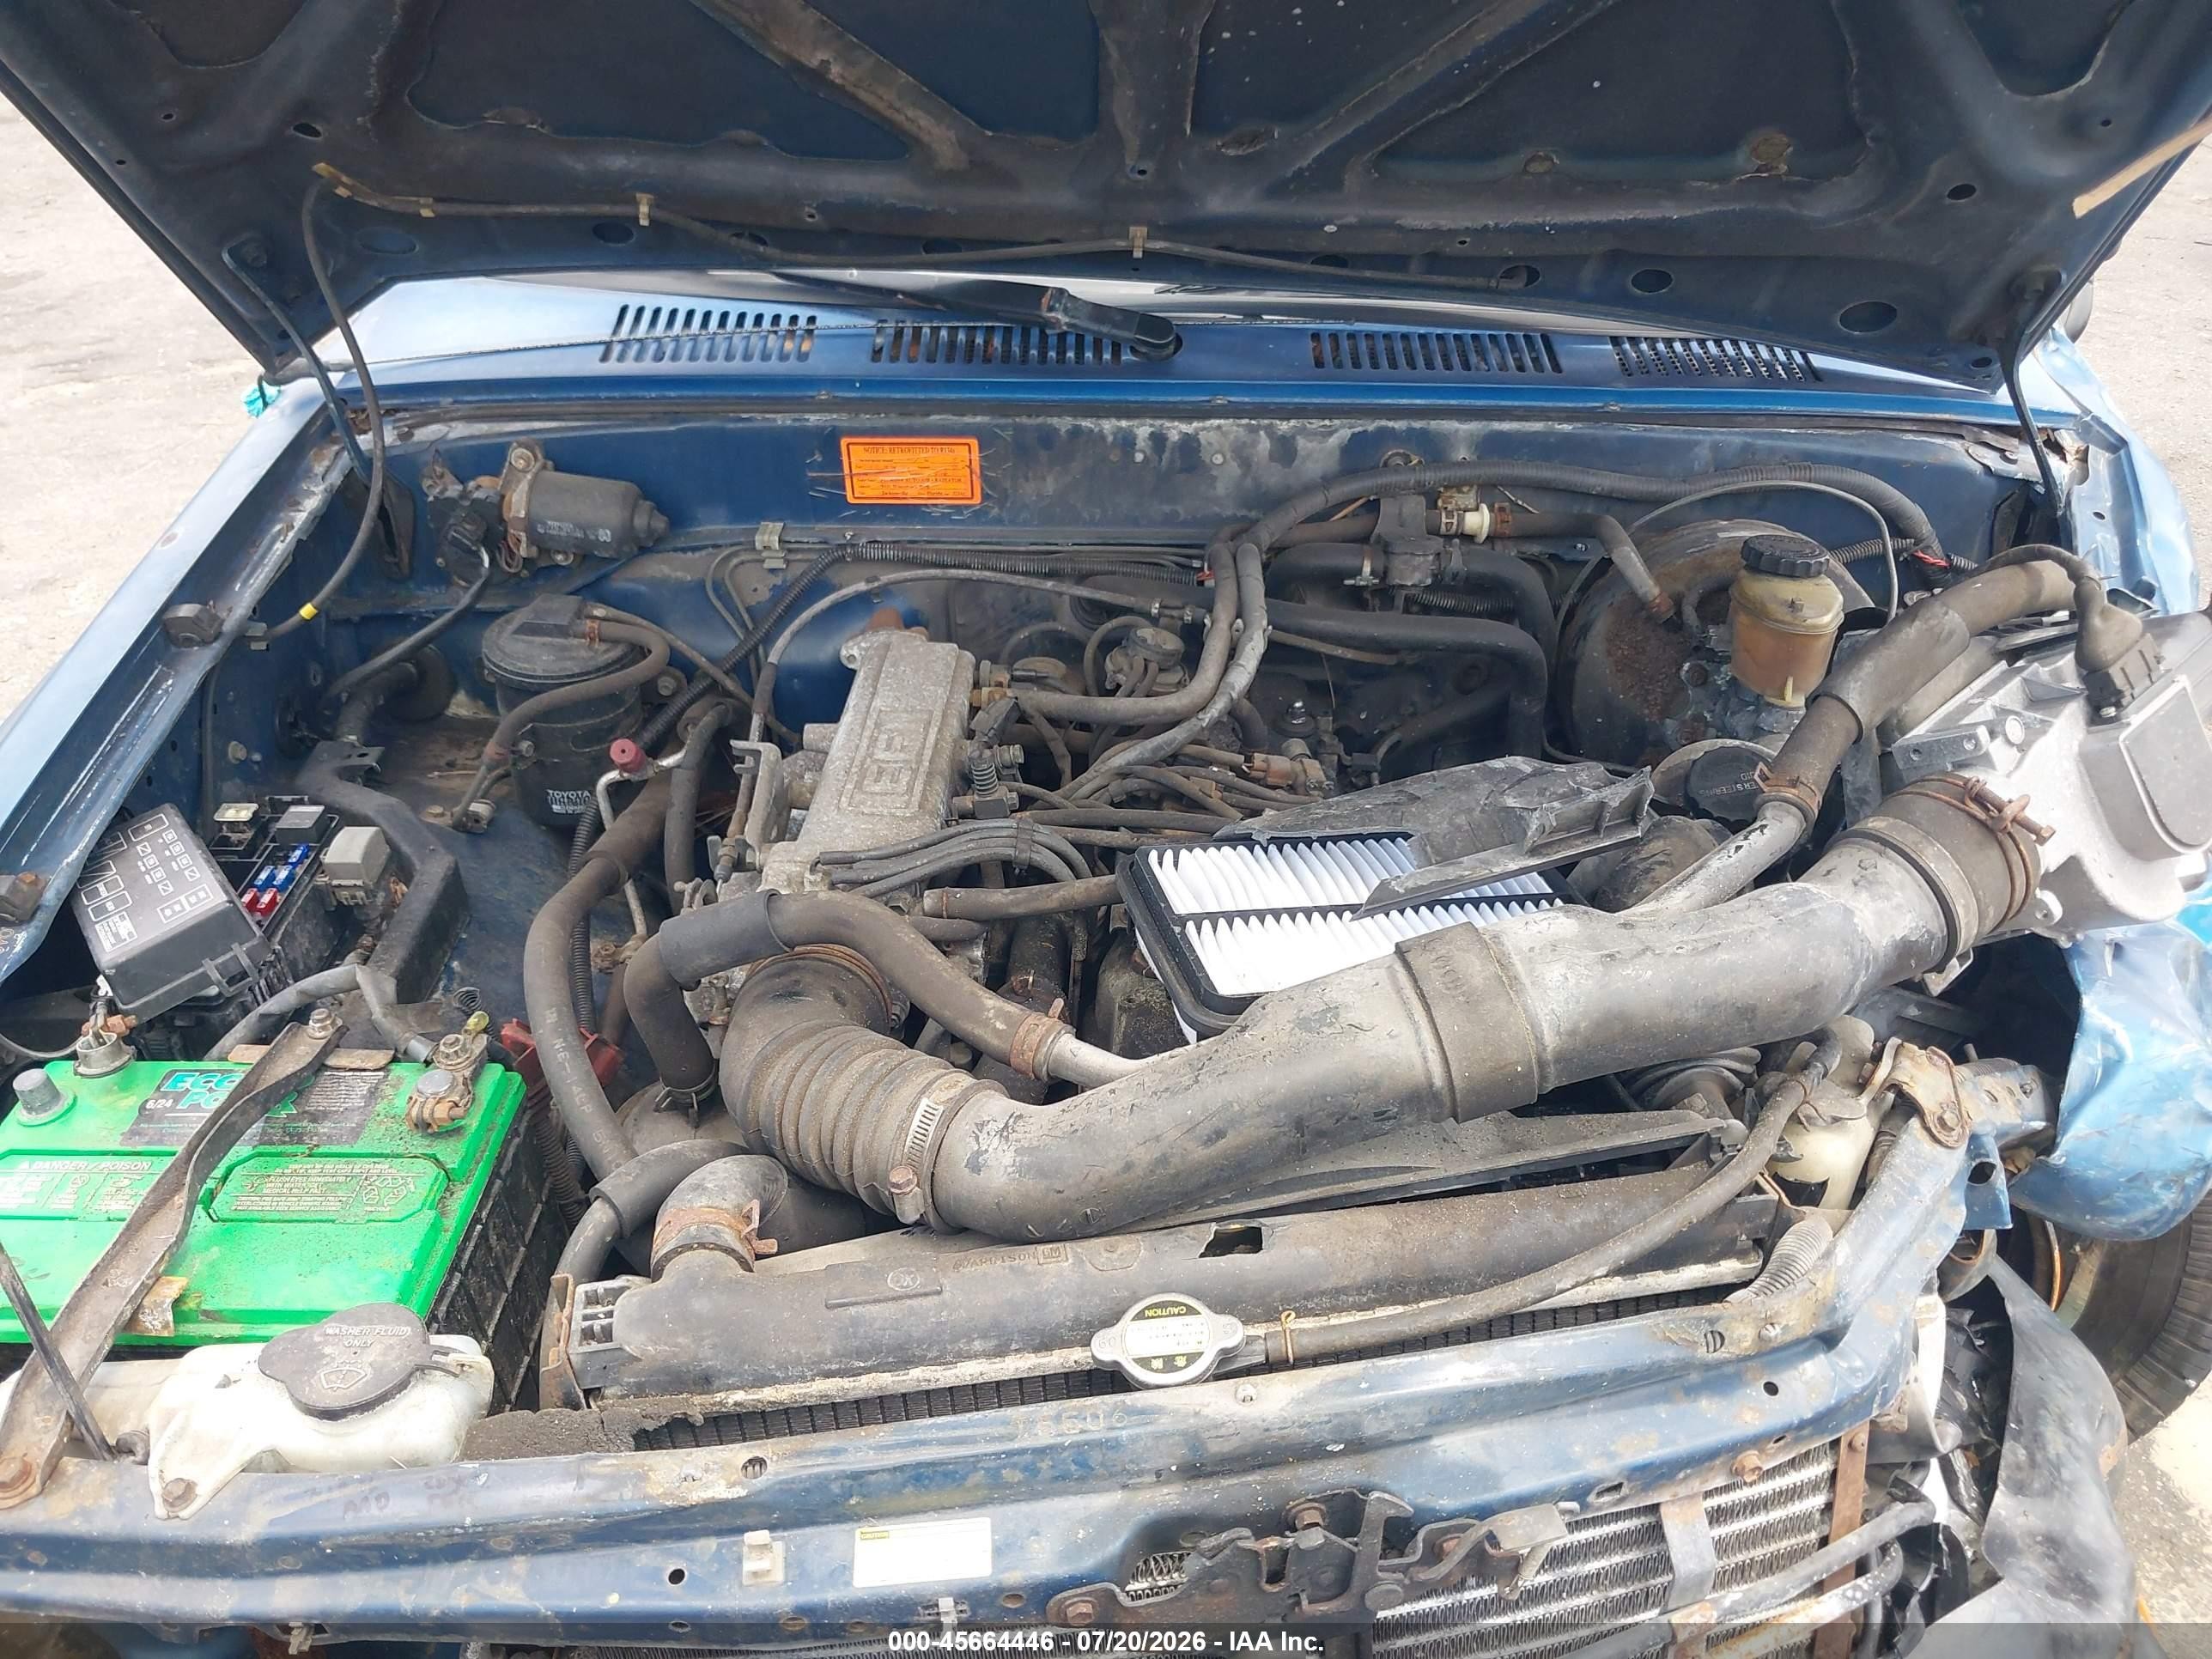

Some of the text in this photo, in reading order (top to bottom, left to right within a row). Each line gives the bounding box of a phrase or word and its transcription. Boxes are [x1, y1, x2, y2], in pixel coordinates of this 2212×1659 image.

[547, 789, 591, 799] TOYOTA
[146, 1099, 173, 1109] 6/24
[33, 1161, 87, 1170] DANGER
[100, 1161, 152, 1170] POISON
[1042, 1246, 1061, 1258] GM
[1145, 1305, 1187, 1317] CAUTION
[325, 1326, 410, 1337] WASHER FLUID
[344, 1339, 374, 1347] ONLY
